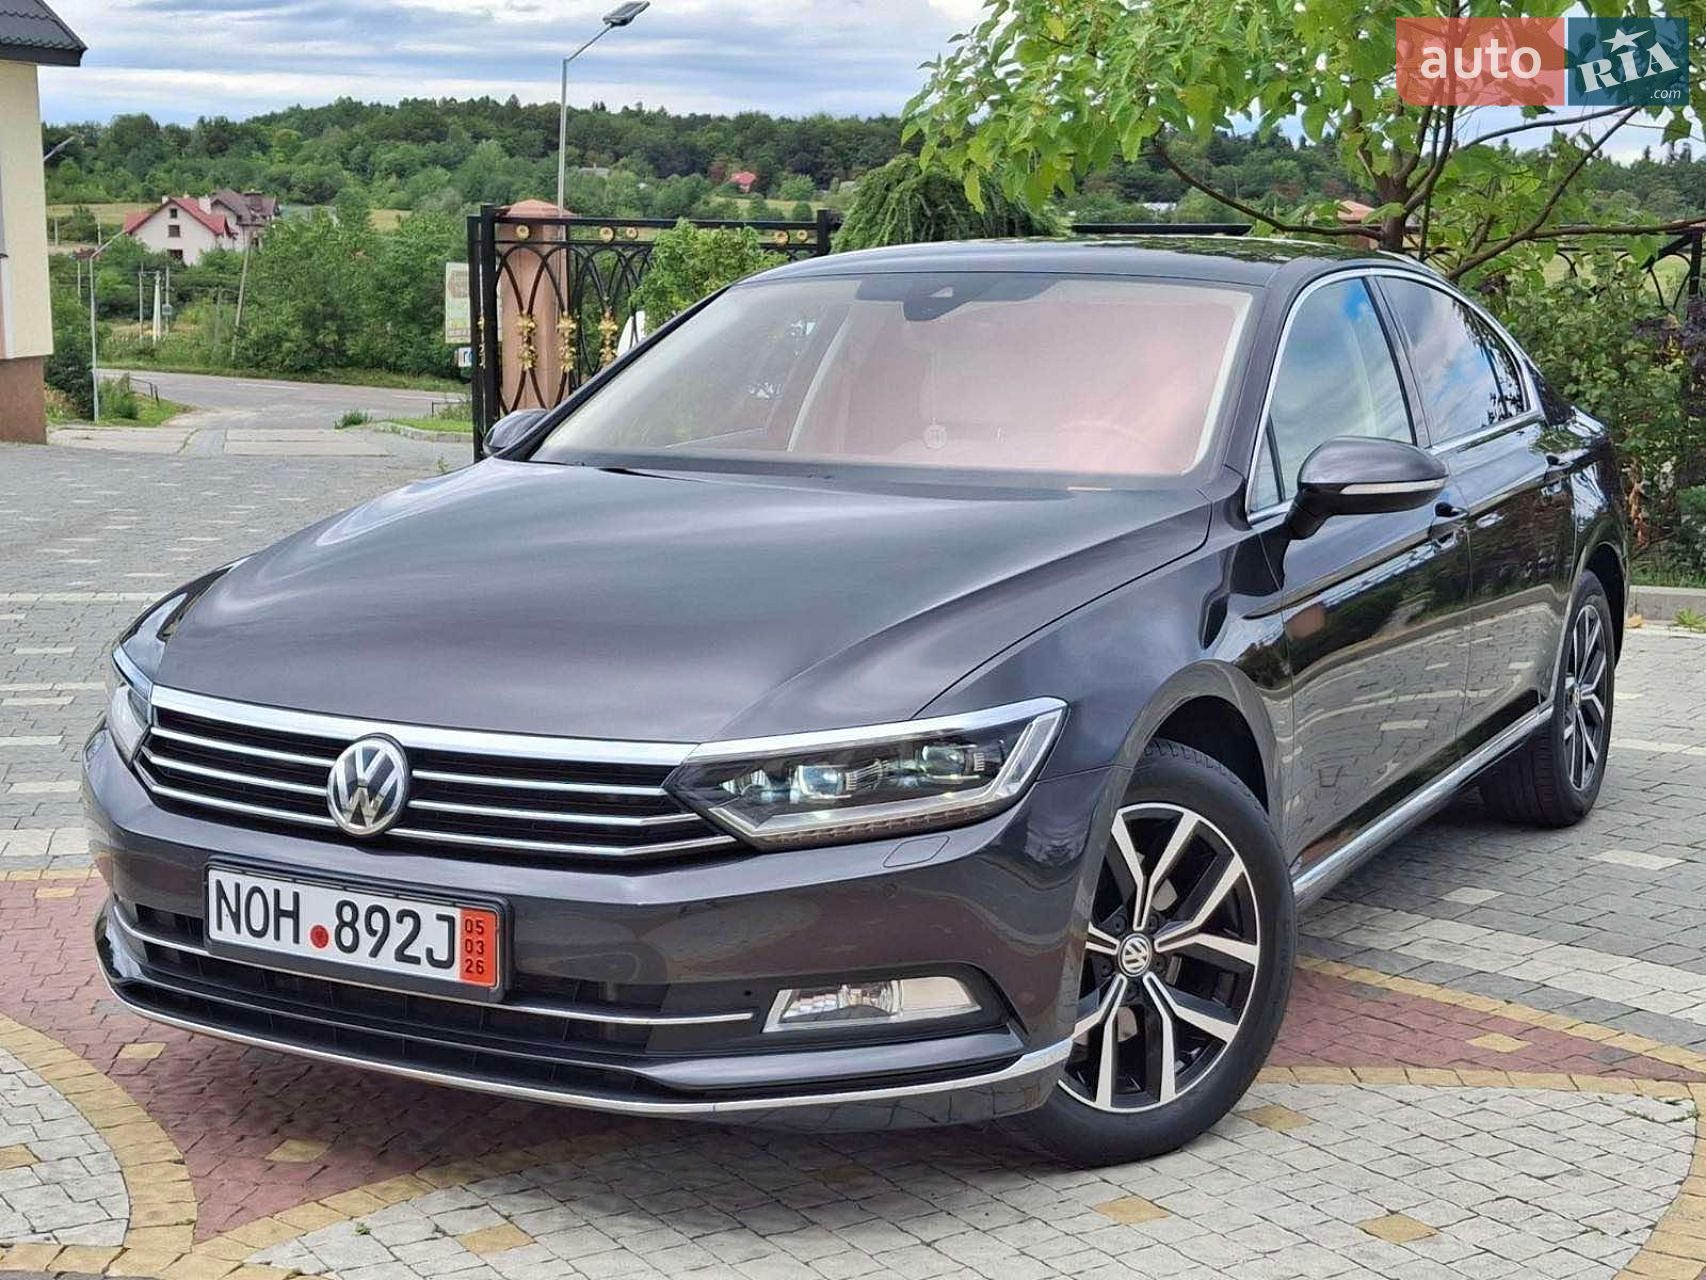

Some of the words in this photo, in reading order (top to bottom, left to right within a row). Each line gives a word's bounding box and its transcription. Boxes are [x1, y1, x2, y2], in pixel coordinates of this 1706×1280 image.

[214, 878, 300, 945] NOH
[334, 899, 455, 969] 892J
[464, 918, 485, 935] 05
[464, 937, 485, 955] 03
[464, 959, 485, 976] 26
